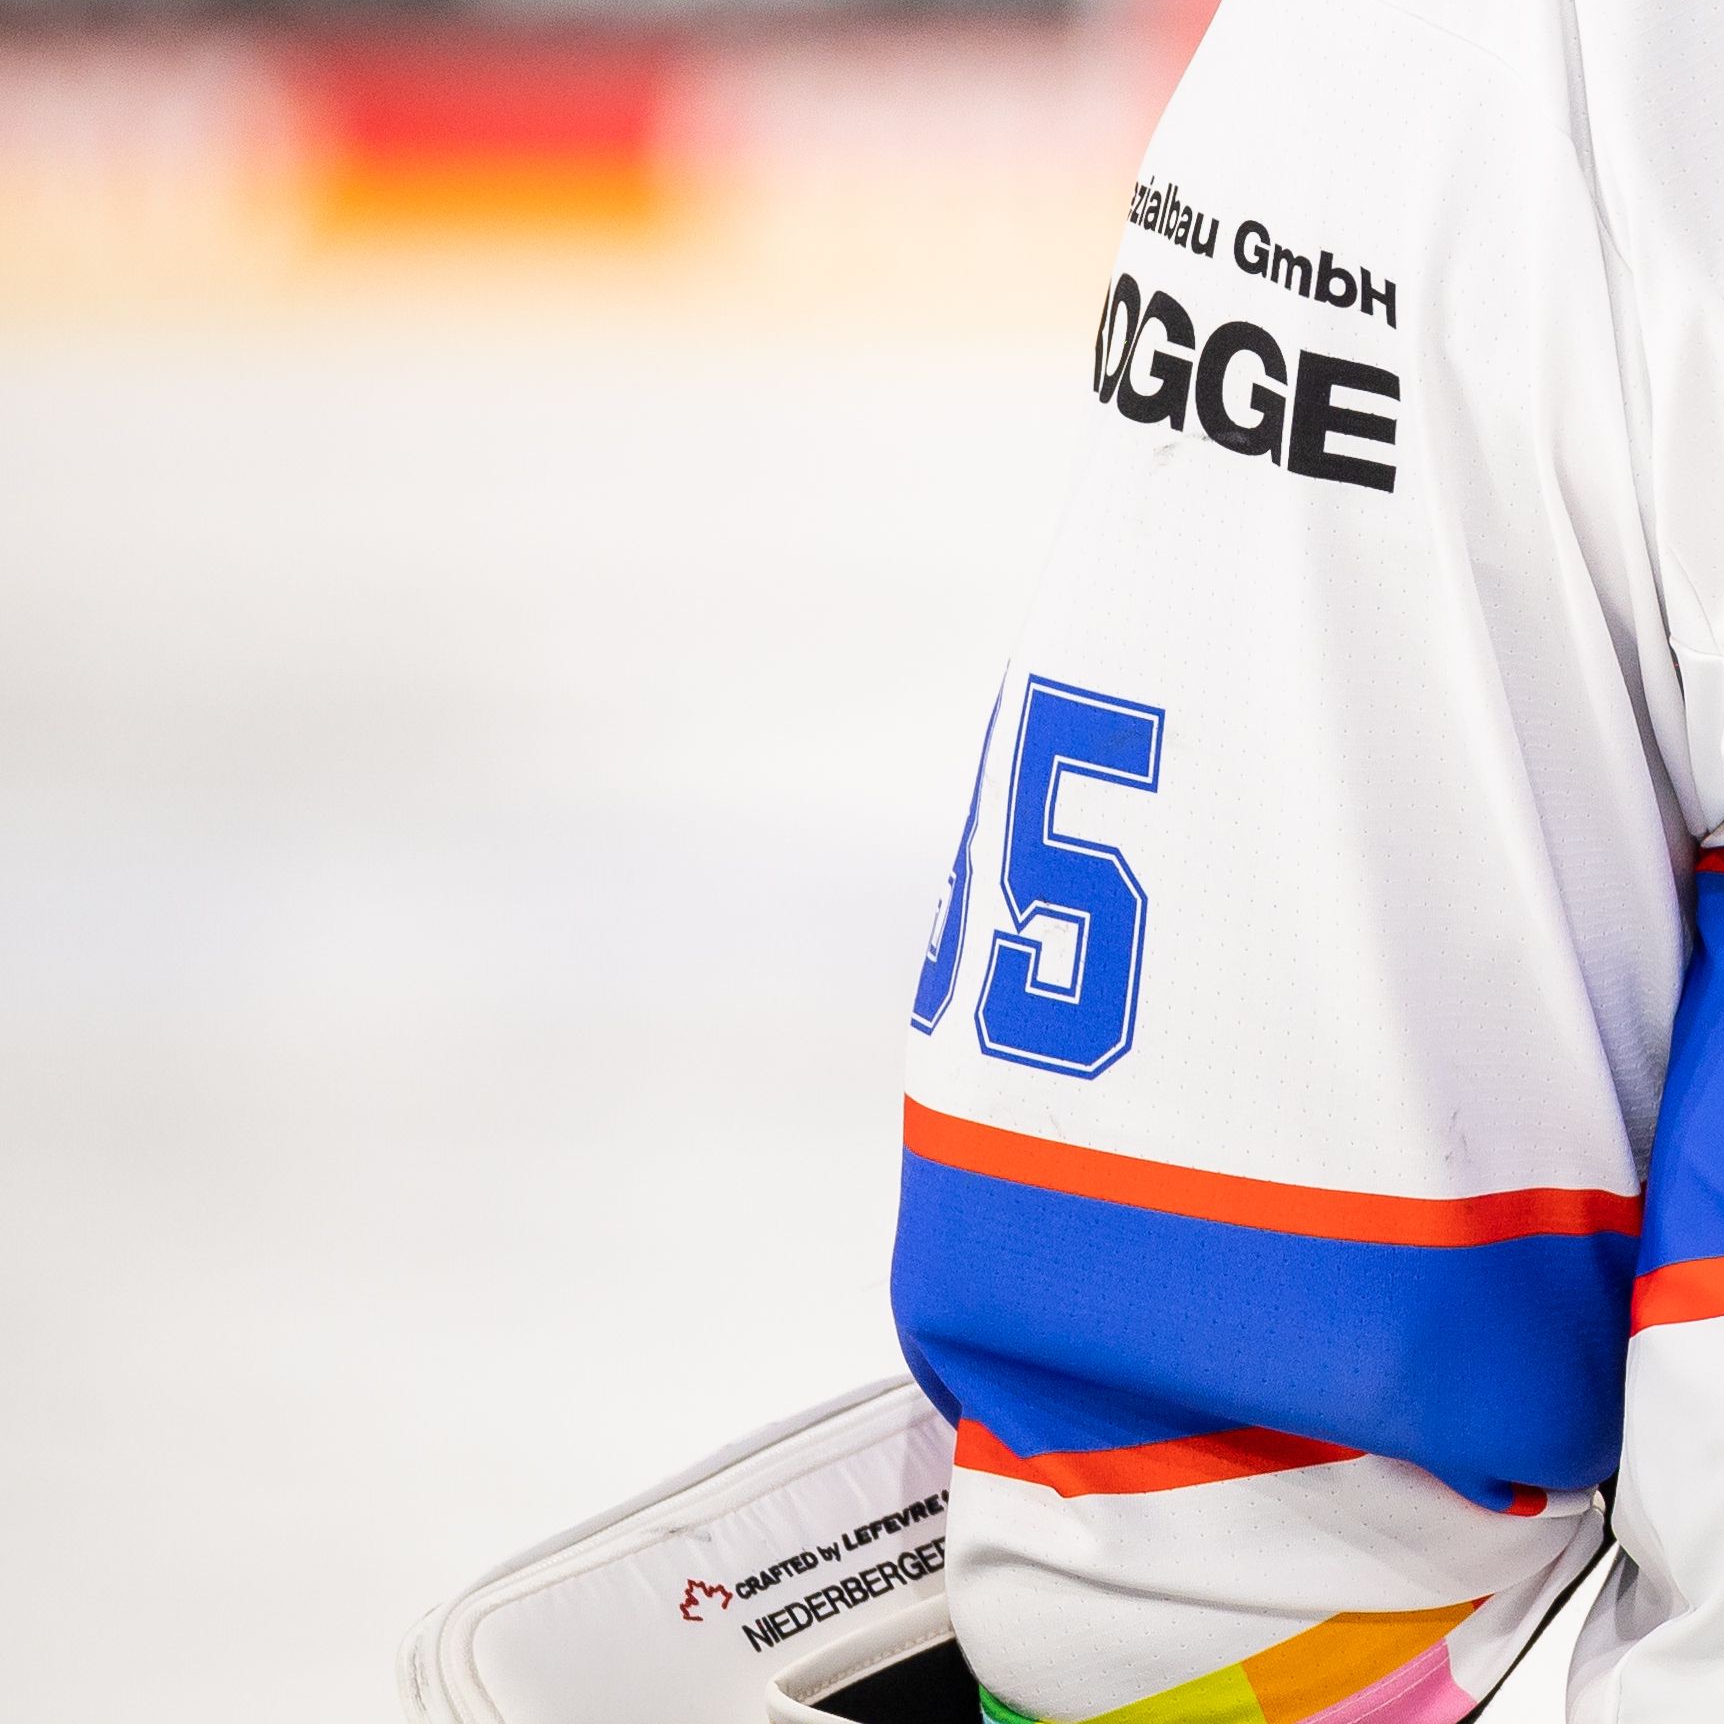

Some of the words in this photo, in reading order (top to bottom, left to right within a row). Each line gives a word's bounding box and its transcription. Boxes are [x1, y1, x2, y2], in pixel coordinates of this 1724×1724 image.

[1126, 174, 1220, 259] zialbau
[1233, 219, 1398, 330] GmbH
[1093, 272, 1402, 494] OGGE
[910, 658, 1167, 1081] 5
[735, 1551, 819, 1600] CRAFTED
[816, 1539, 842, 1563] by
